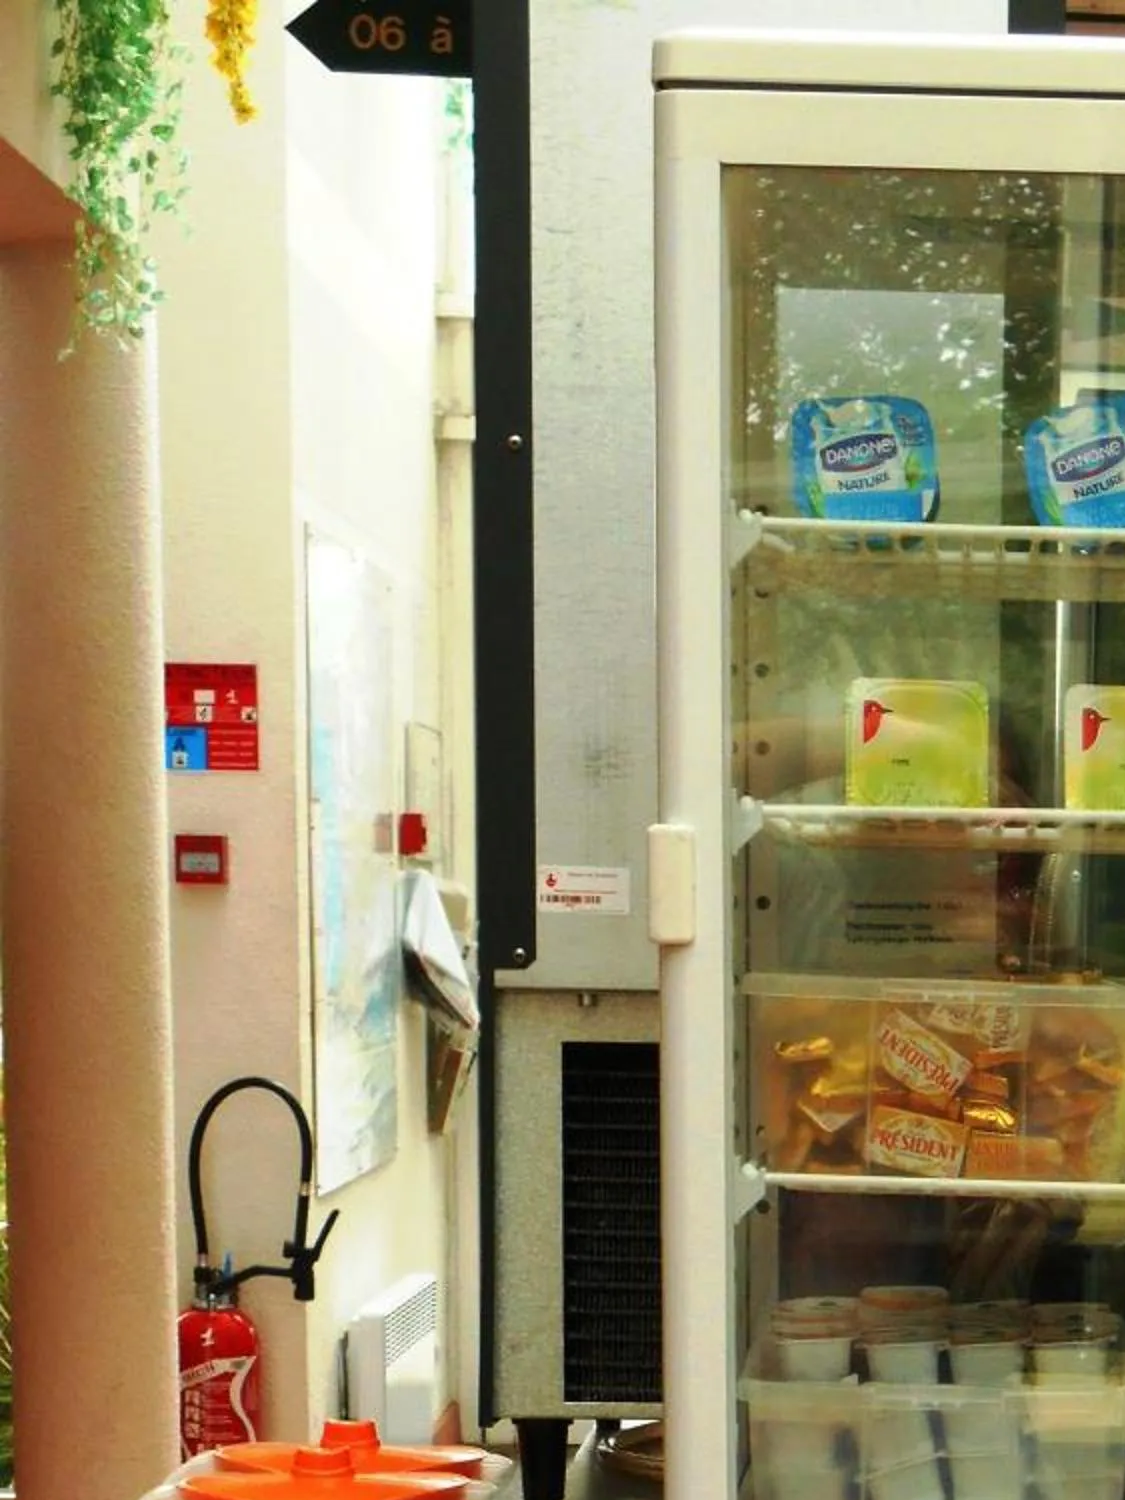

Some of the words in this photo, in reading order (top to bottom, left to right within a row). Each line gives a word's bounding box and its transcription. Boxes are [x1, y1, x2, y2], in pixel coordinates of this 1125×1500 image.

[349, 13, 407, 51] 06
[431, 15, 453, 54] à
[825, 437, 895, 466] DANONE
[1055, 440, 1122, 475] DANONE
[837, 470, 891, 492] NATURE
[1072, 471, 1125, 500] NATURE
